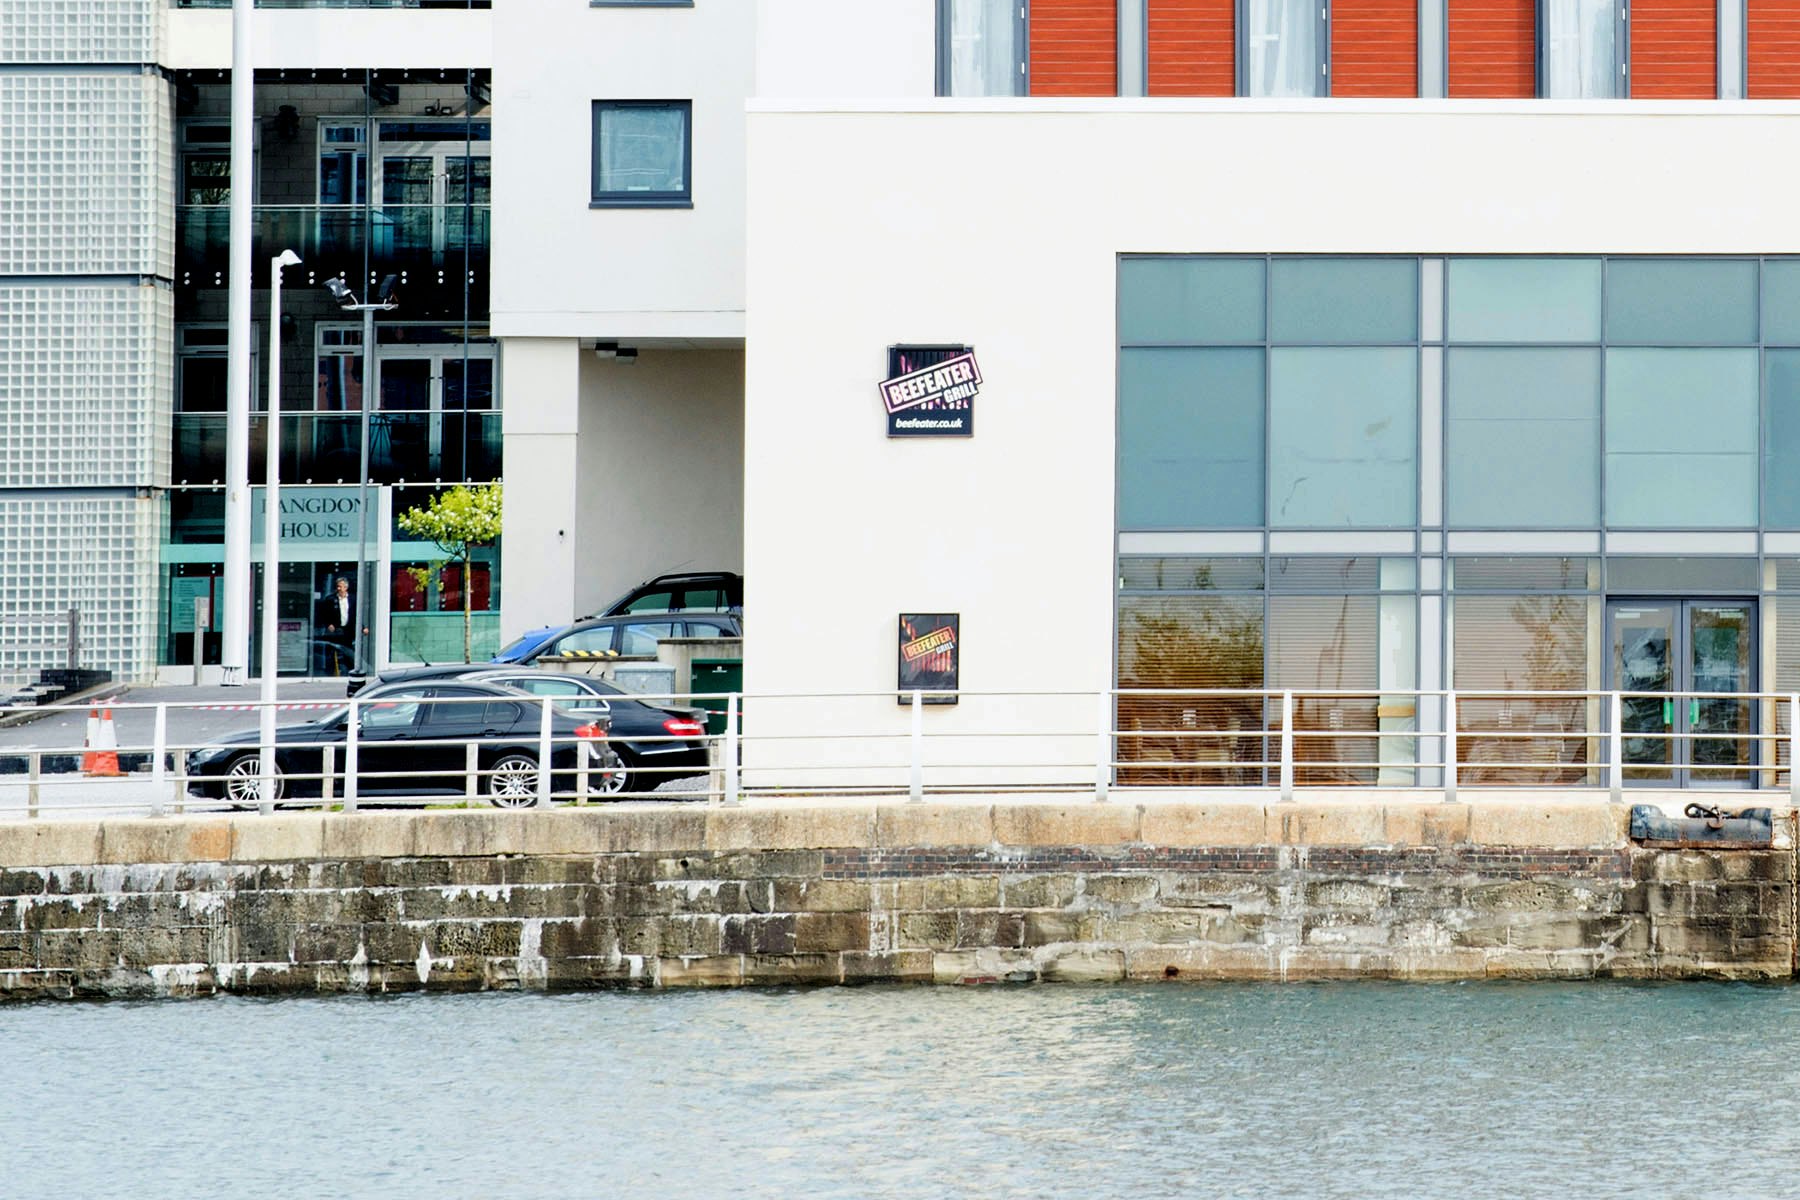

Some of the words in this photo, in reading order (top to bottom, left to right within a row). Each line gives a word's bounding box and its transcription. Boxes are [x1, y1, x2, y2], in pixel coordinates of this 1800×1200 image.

[888, 361, 974, 406] BEEFEATER
[943, 381, 978, 403] GRILL
[895, 418, 963, 428] beefeater.co.uk
[281, 522, 350, 538] HOUSE
[905, 631, 952, 658] BEEFEATER
